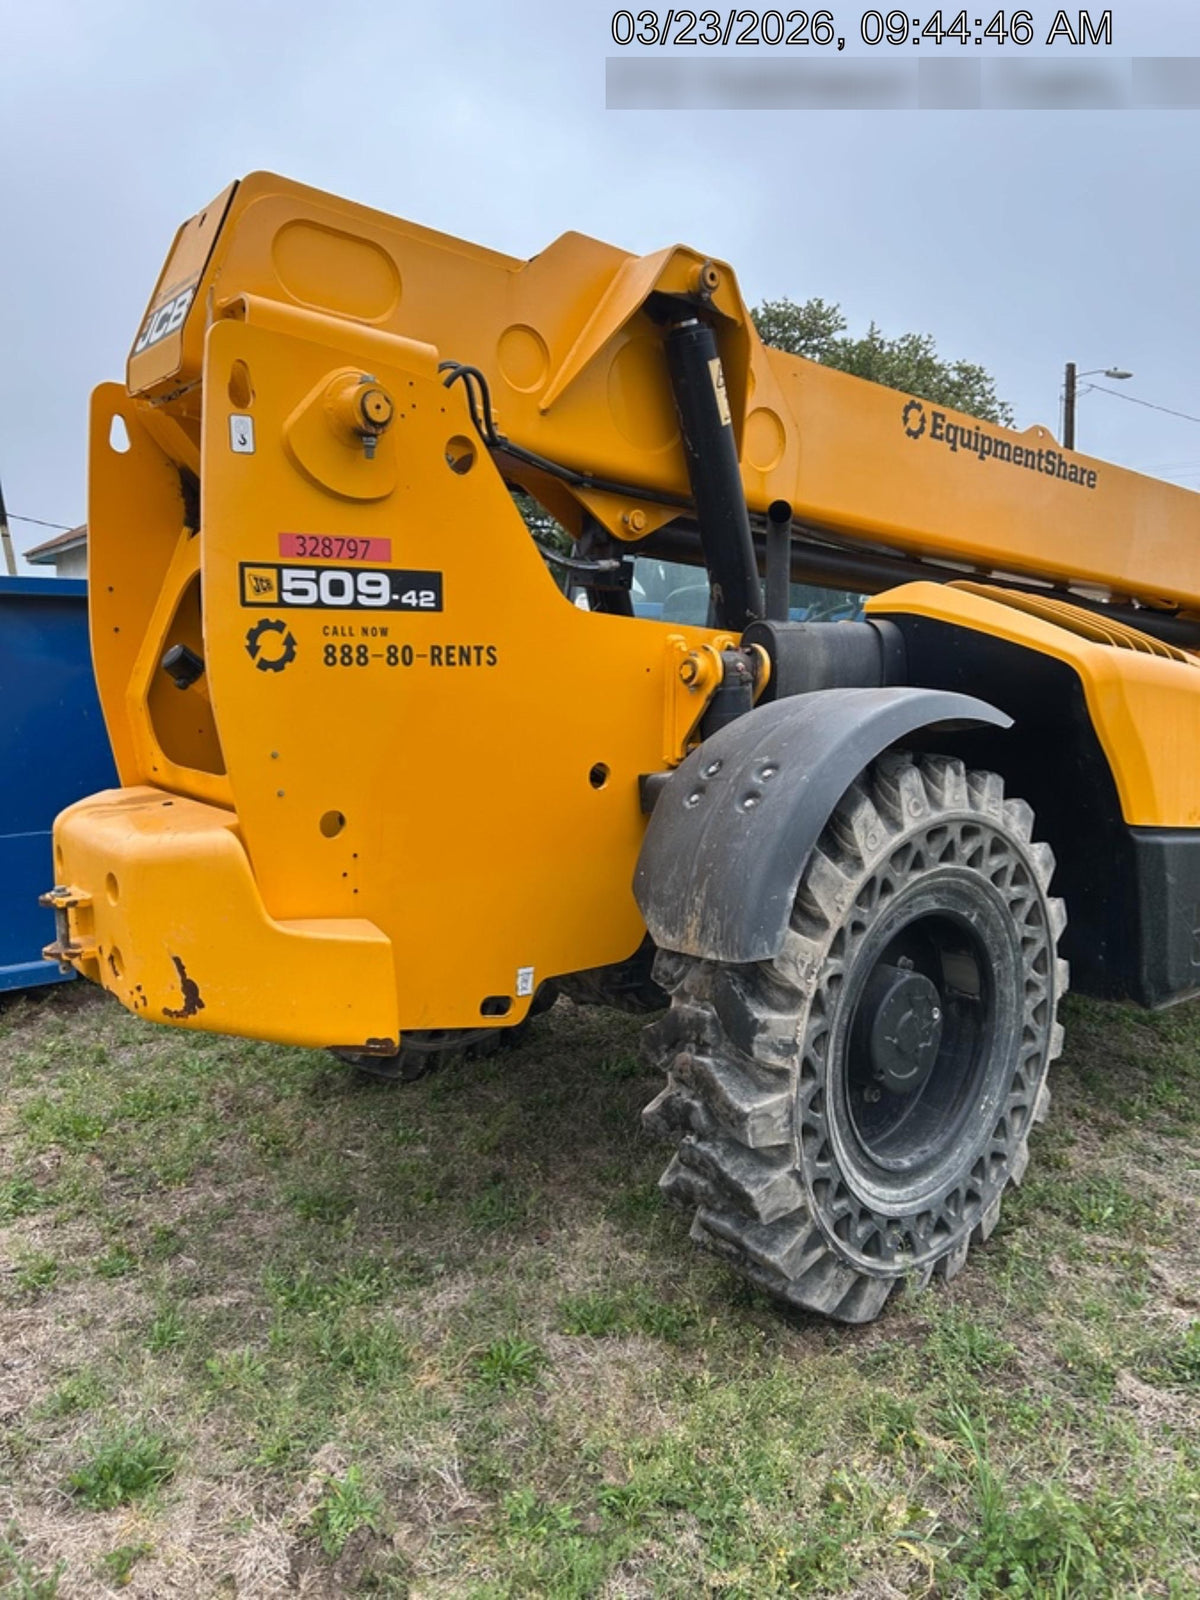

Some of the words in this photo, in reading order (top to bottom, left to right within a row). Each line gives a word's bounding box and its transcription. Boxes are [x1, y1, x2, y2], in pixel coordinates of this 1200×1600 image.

[135, 286, 195, 353] JCB
[929, 410, 1098, 489] EquipmentShare
[295, 534, 371, 560] 328797
[322, 625, 355, 637] CALL
[361, 626, 389, 638] NOW
[323, 643, 498, 667] 888-80-RENTS
